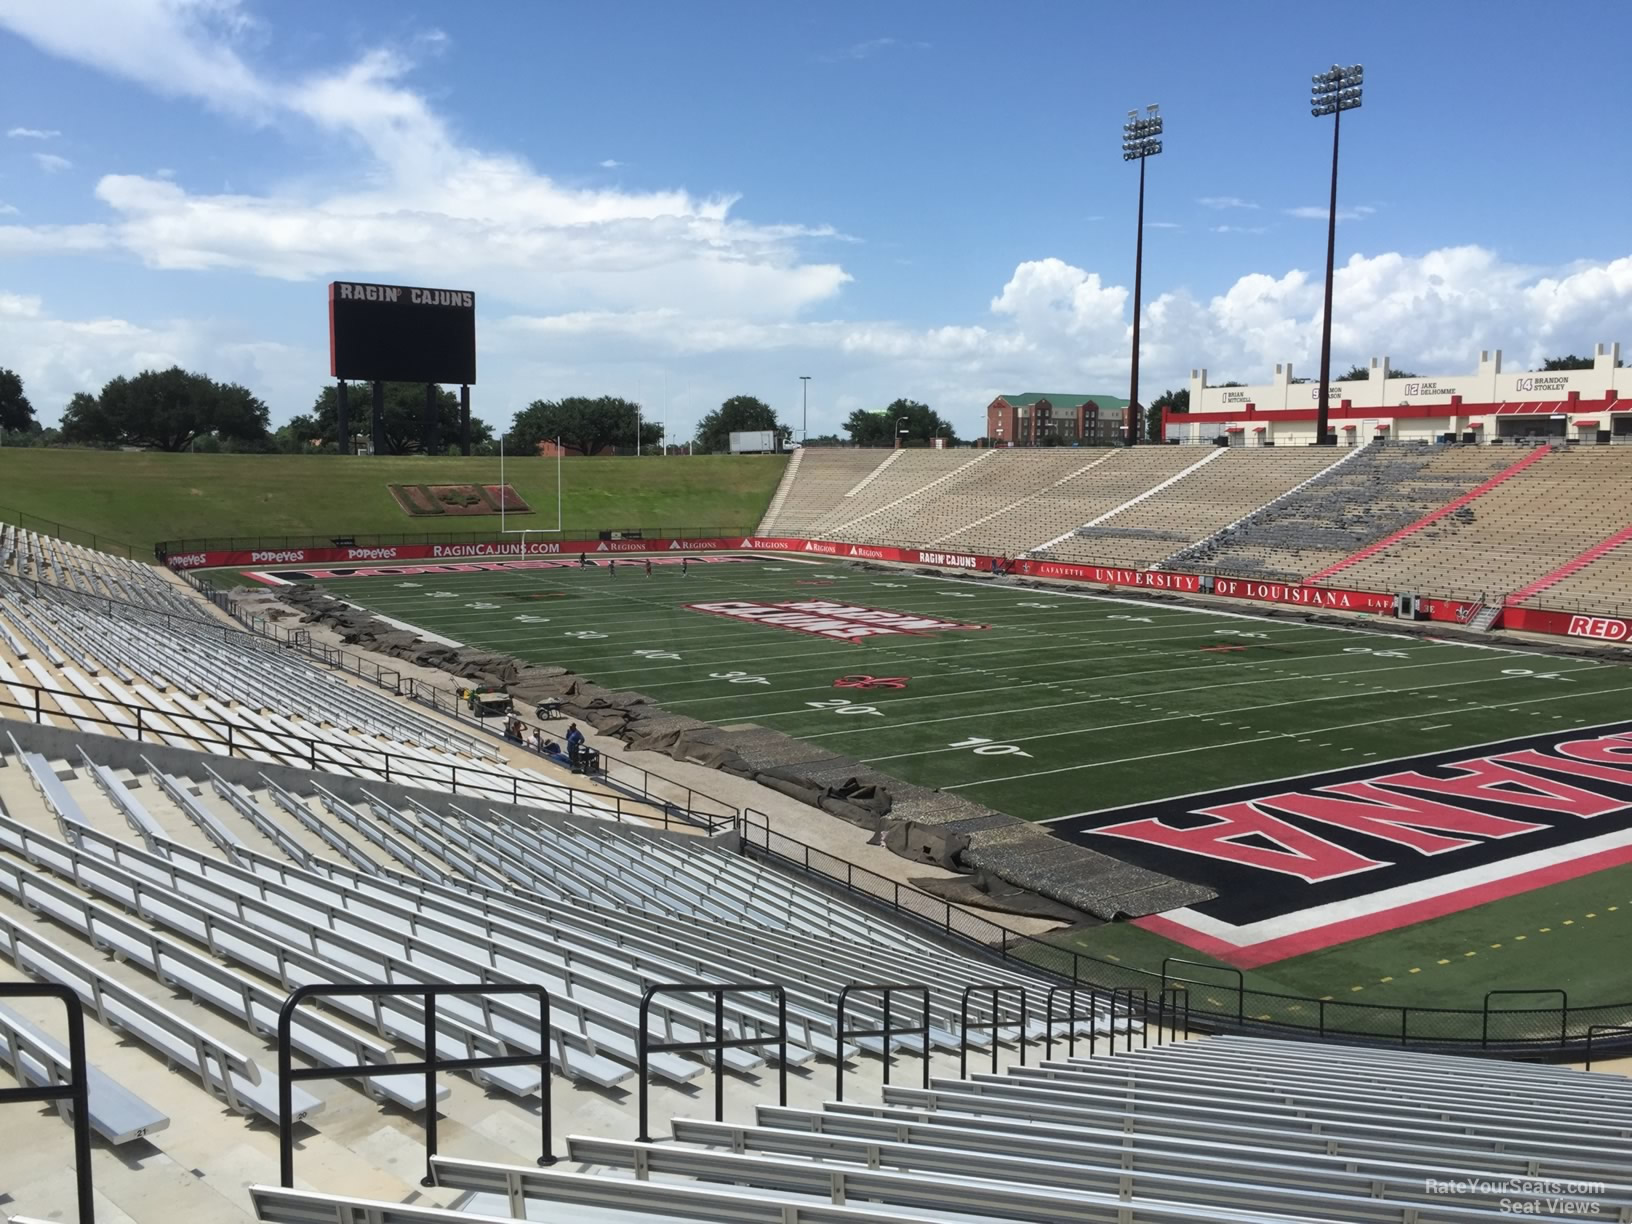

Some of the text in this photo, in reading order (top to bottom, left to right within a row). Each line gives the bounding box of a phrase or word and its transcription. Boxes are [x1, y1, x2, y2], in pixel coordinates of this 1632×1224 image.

[340, 284, 473, 307] RAGIN' CAJUNS
[1405, 384, 1420, 396] 12
[1516, 379, 1533, 391] 14
[1421, 388, 1456, 396] DELHOMME
[433, 543, 560, 557] RAGINCAJUNS.COM
[610, 543, 646, 551] REGIONS
[682, 541, 717, 549] REGIONS
[754, 540, 788, 549] REGIONS
[813, 543, 836, 553] REGIONS
[858, 547, 883, 557] REGIONS
[945, 555, 976, 568] CAJUNS
[1040, 565, 1084, 577] LAFAYETTE
[1096, 569, 1194, 590] UNIVERSITY
[1217, 580, 1237, 594] OF
[1247, 584, 1350, 607] LOUISIANA
[1568, 615, 1627, 640] RED
[805, 699, 879, 717] 20
[948, 736, 1020, 756] 10
[136, 1128, 147, 1138] 21
